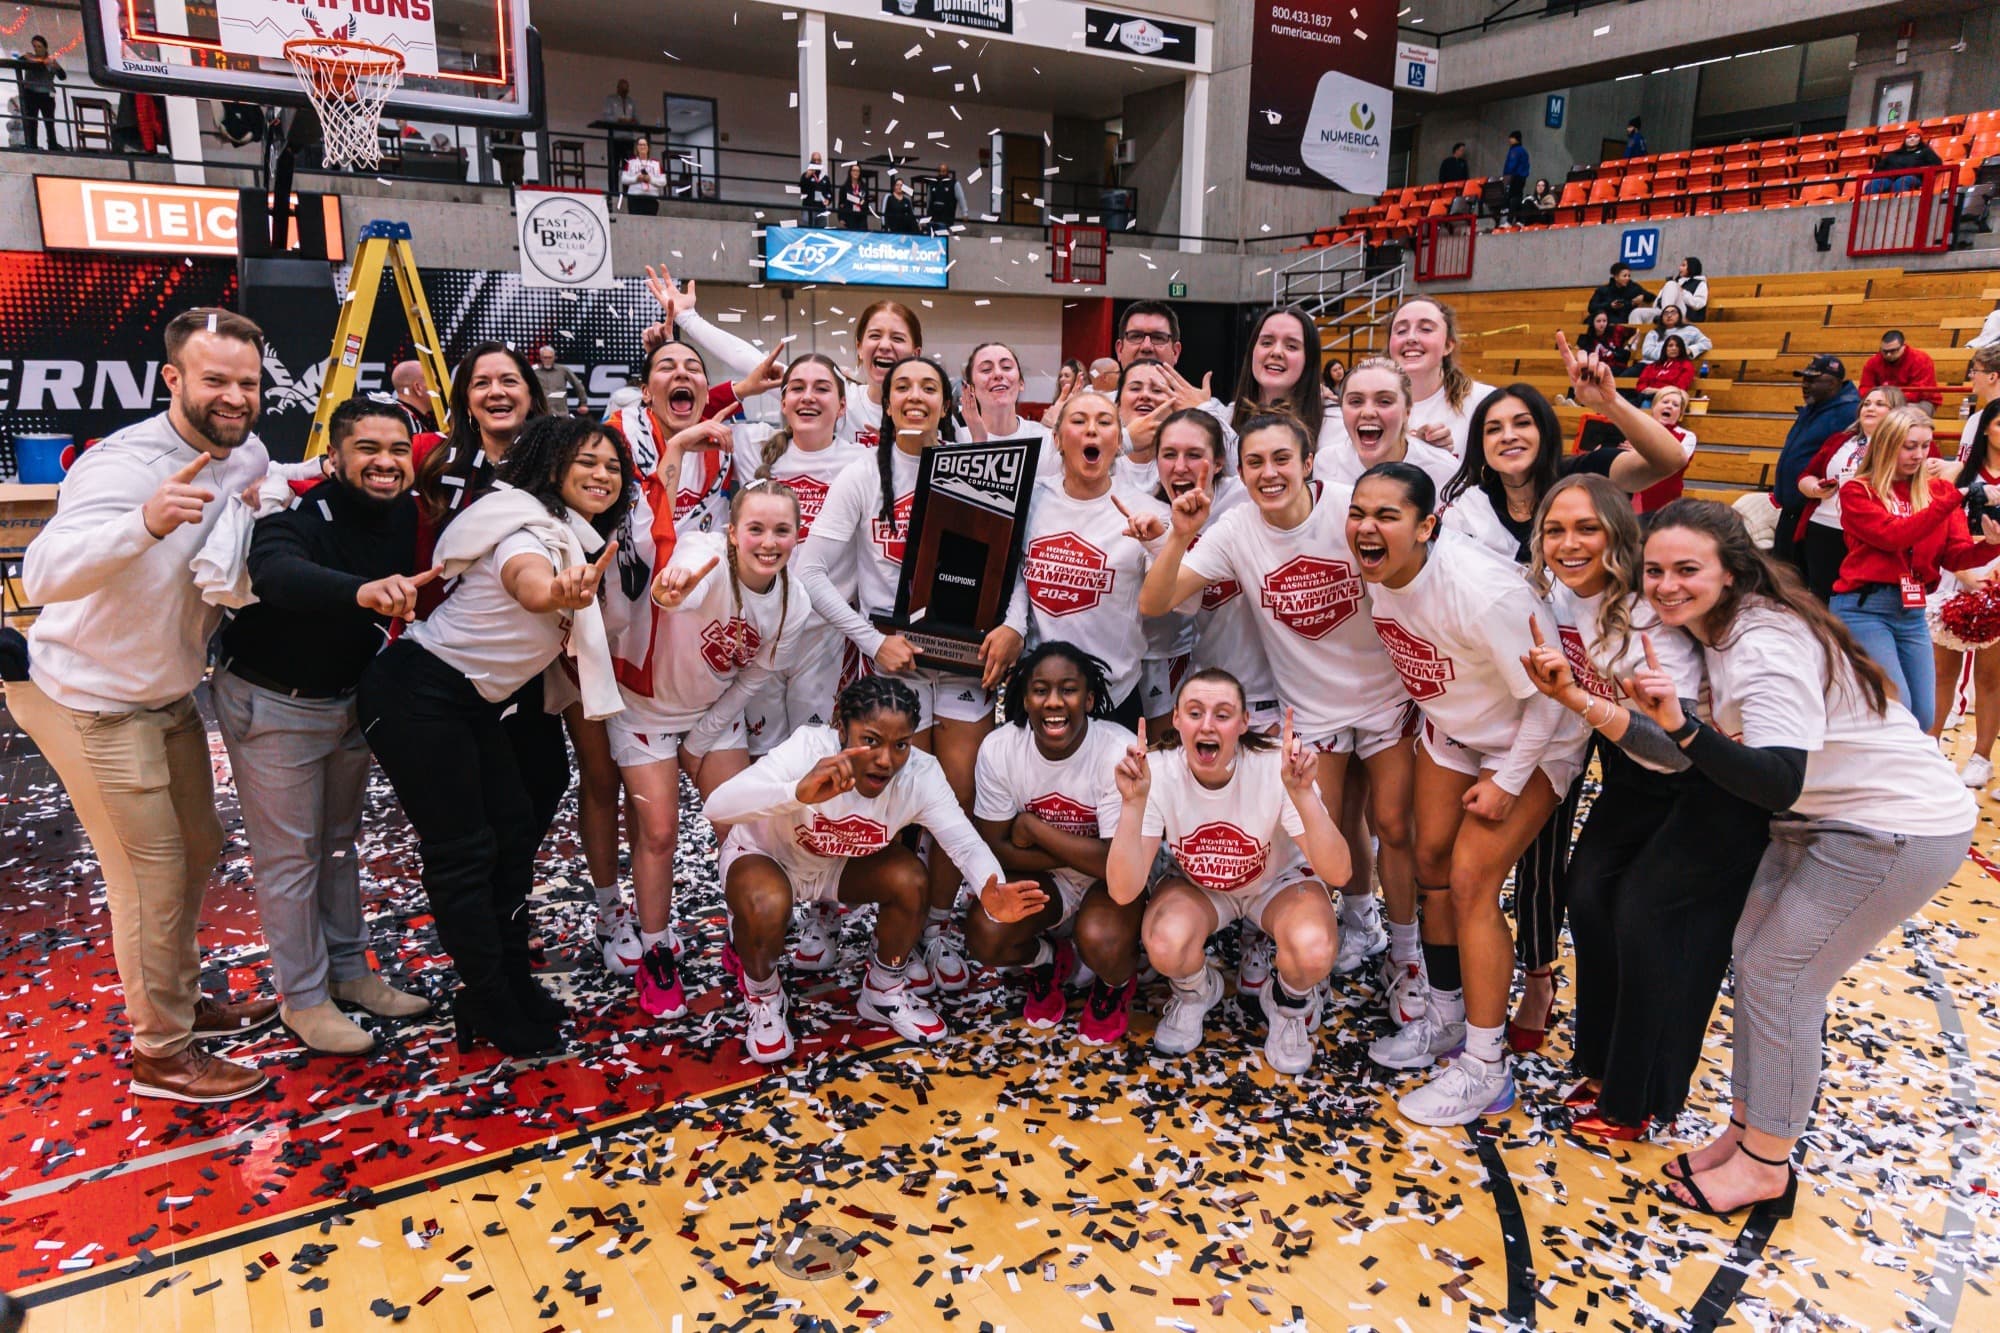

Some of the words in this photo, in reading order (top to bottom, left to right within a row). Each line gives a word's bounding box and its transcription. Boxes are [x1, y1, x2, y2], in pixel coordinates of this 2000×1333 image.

[1272, 6, 1332, 27] 800.433.1837
[1271, 23, 1341, 45] numericacu.com
[122, 61, 168, 75] SPALDING
[1551, 98, 1561, 113] M
[1320, 129, 1379, 147] NUMERICA
[533, 217, 567, 234] FAST
[541, 229, 587, 247] BREAK
[1624, 234, 1655, 257] LN
[794, 244, 828, 264] TDS
[1173, 284, 1184, 296] EXIT
[968, 478, 1015, 492] CONFERENCE
[1039, 551, 1089, 566] BASKETBALL
[1046, 545, 1085, 557] WOMEN'S
[939, 573, 976, 586] CHAMPIONS
[1053, 565, 1107, 579] CONFERENCE
[1284, 570, 1326, 583] WOMEN'S
[1280, 575, 1334, 590] BASKETBALL
[1037, 587, 1079, 602] 2024
[1204, 585, 1222, 596] 24
[1281, 593, 1298, 601] SKY
[1300, 580, 1358, 600] CONFERENCE
[1291, 609, 1337, 628] 2024
[904, 632, 936, 646] EASTERN
[937, 640, 979, 652] WASHINGTO
[921, 646, 964, 659] UNIVERSITY
[1038, 807, 1077, 816] WOMEN'S
[1195, 845, 1244, 854] BASKETBALL
[1199, 837, 1239, 847] WOMEN'S
